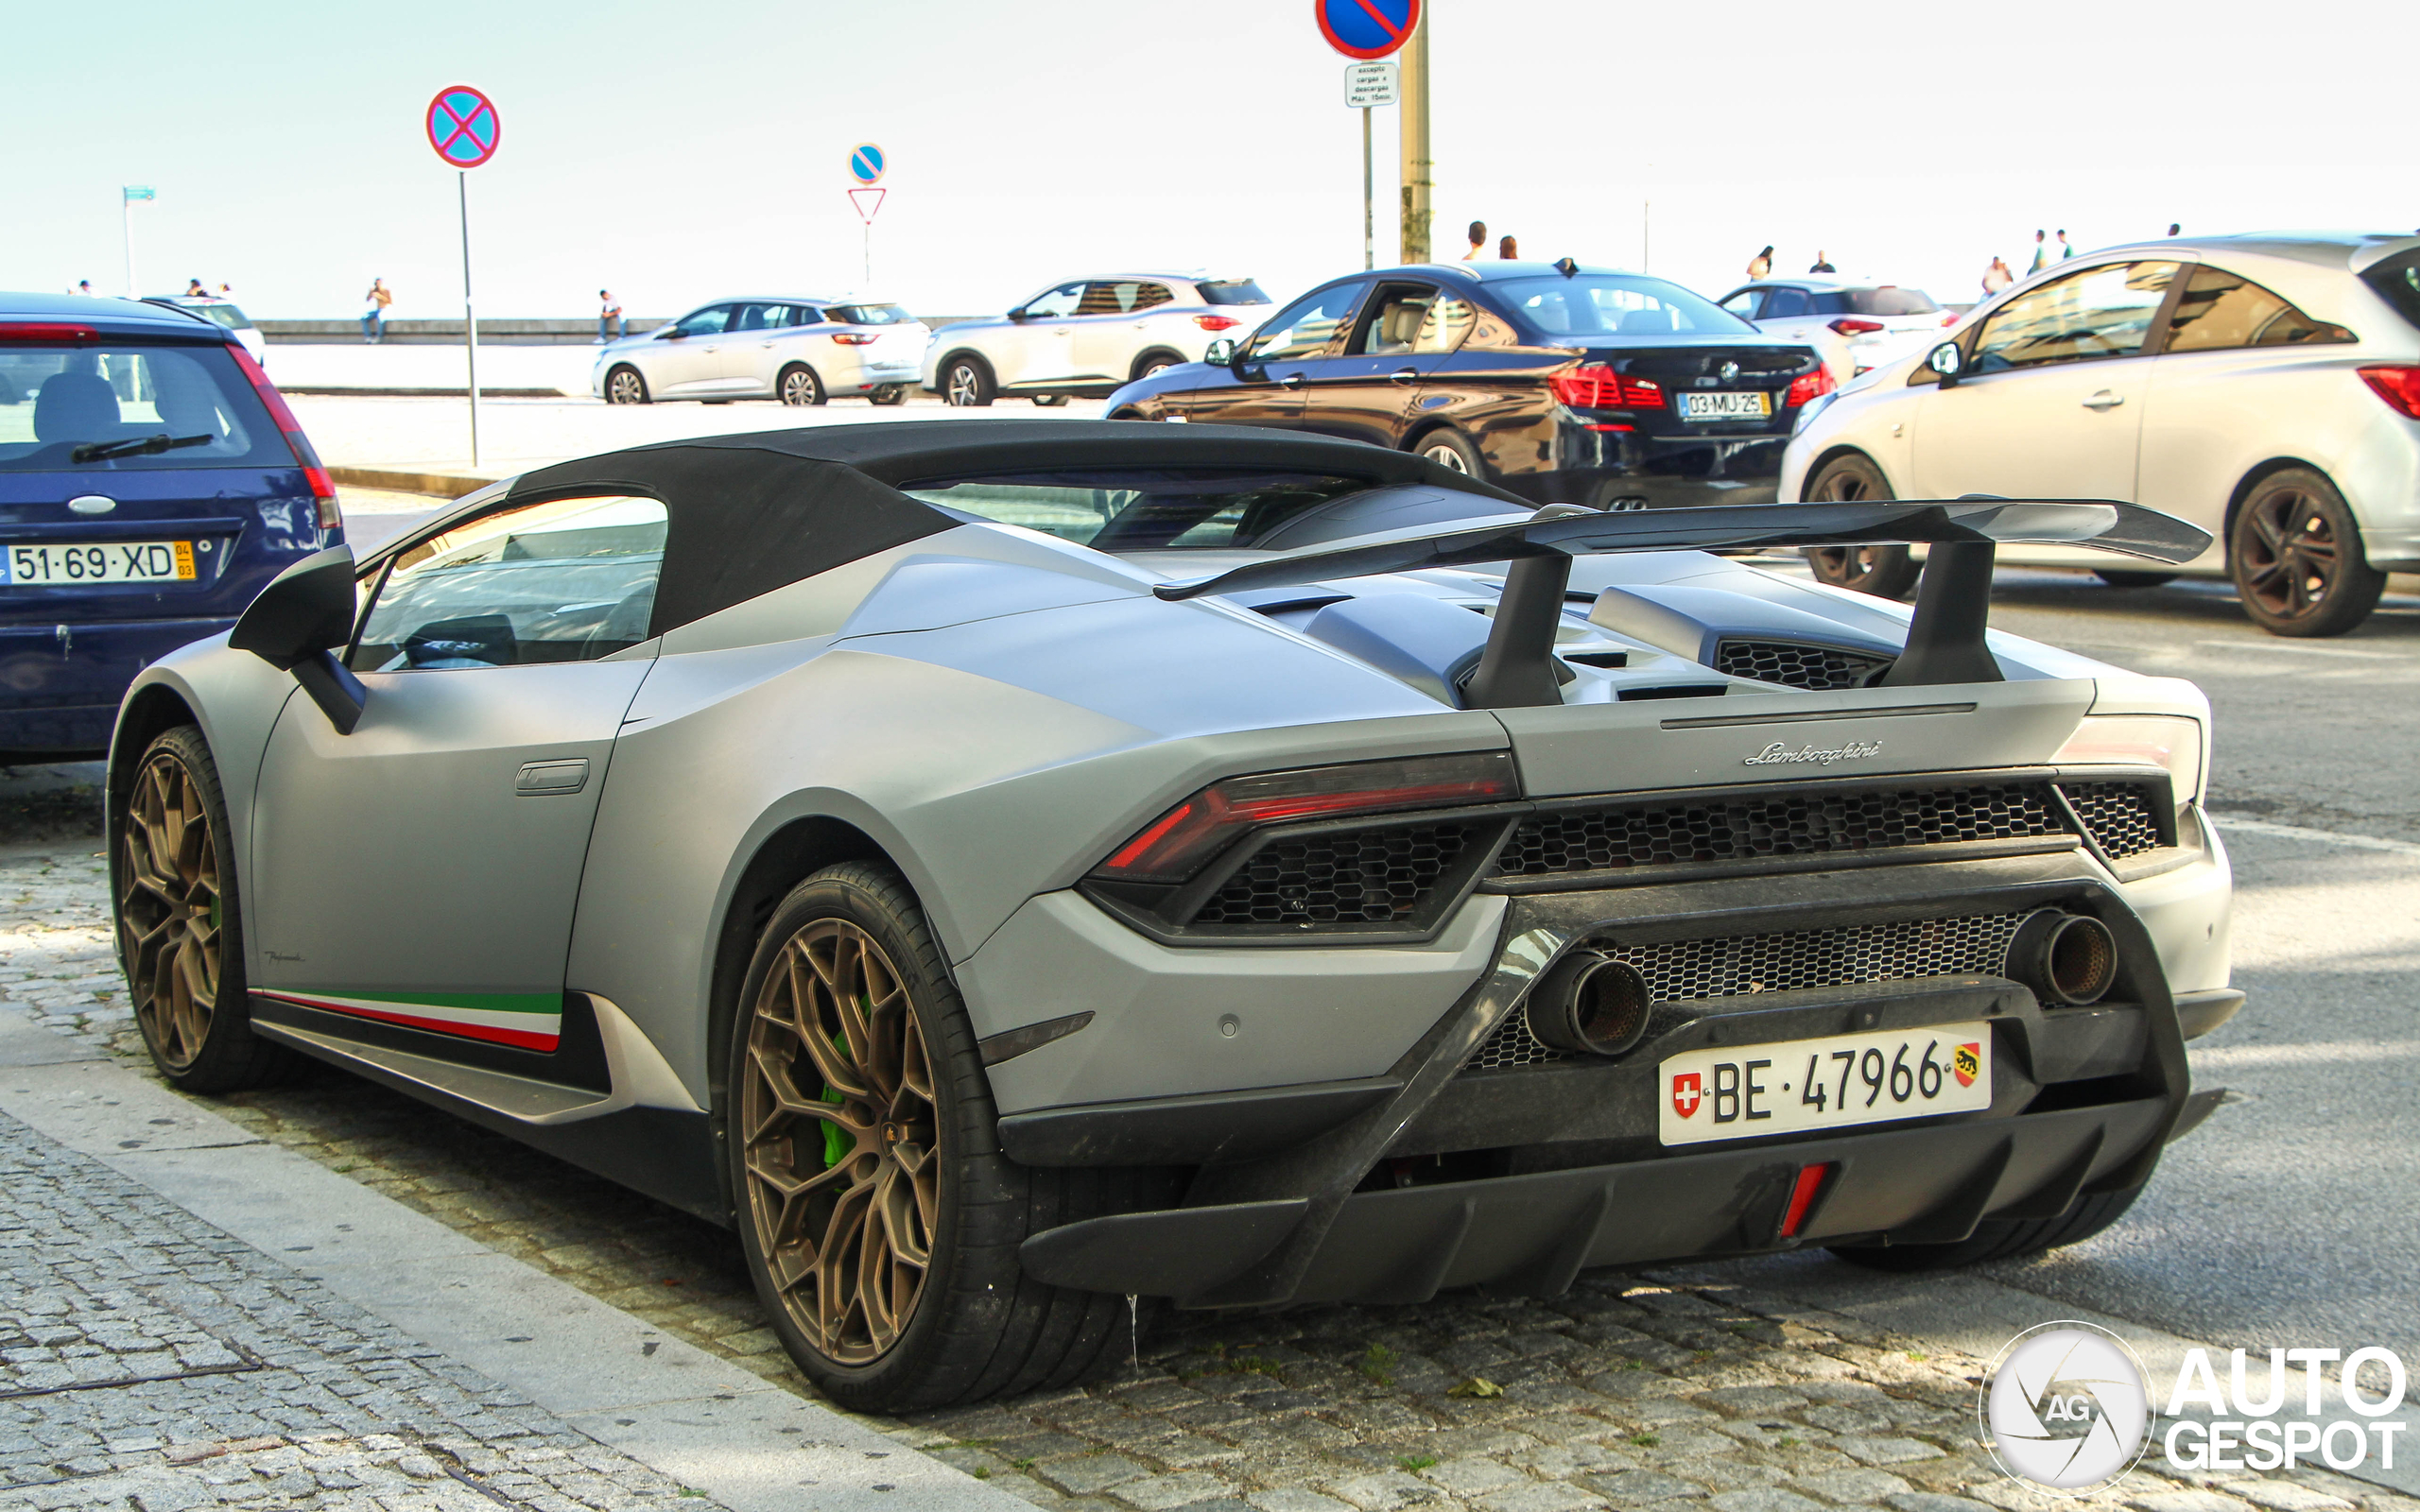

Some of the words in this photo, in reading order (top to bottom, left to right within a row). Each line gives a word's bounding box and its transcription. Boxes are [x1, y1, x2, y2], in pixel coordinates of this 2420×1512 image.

[176, 544, 189, 556] 04
[178, 565, 193, 576] 03
[1744, 740, 1883, 766] Lamborghini
